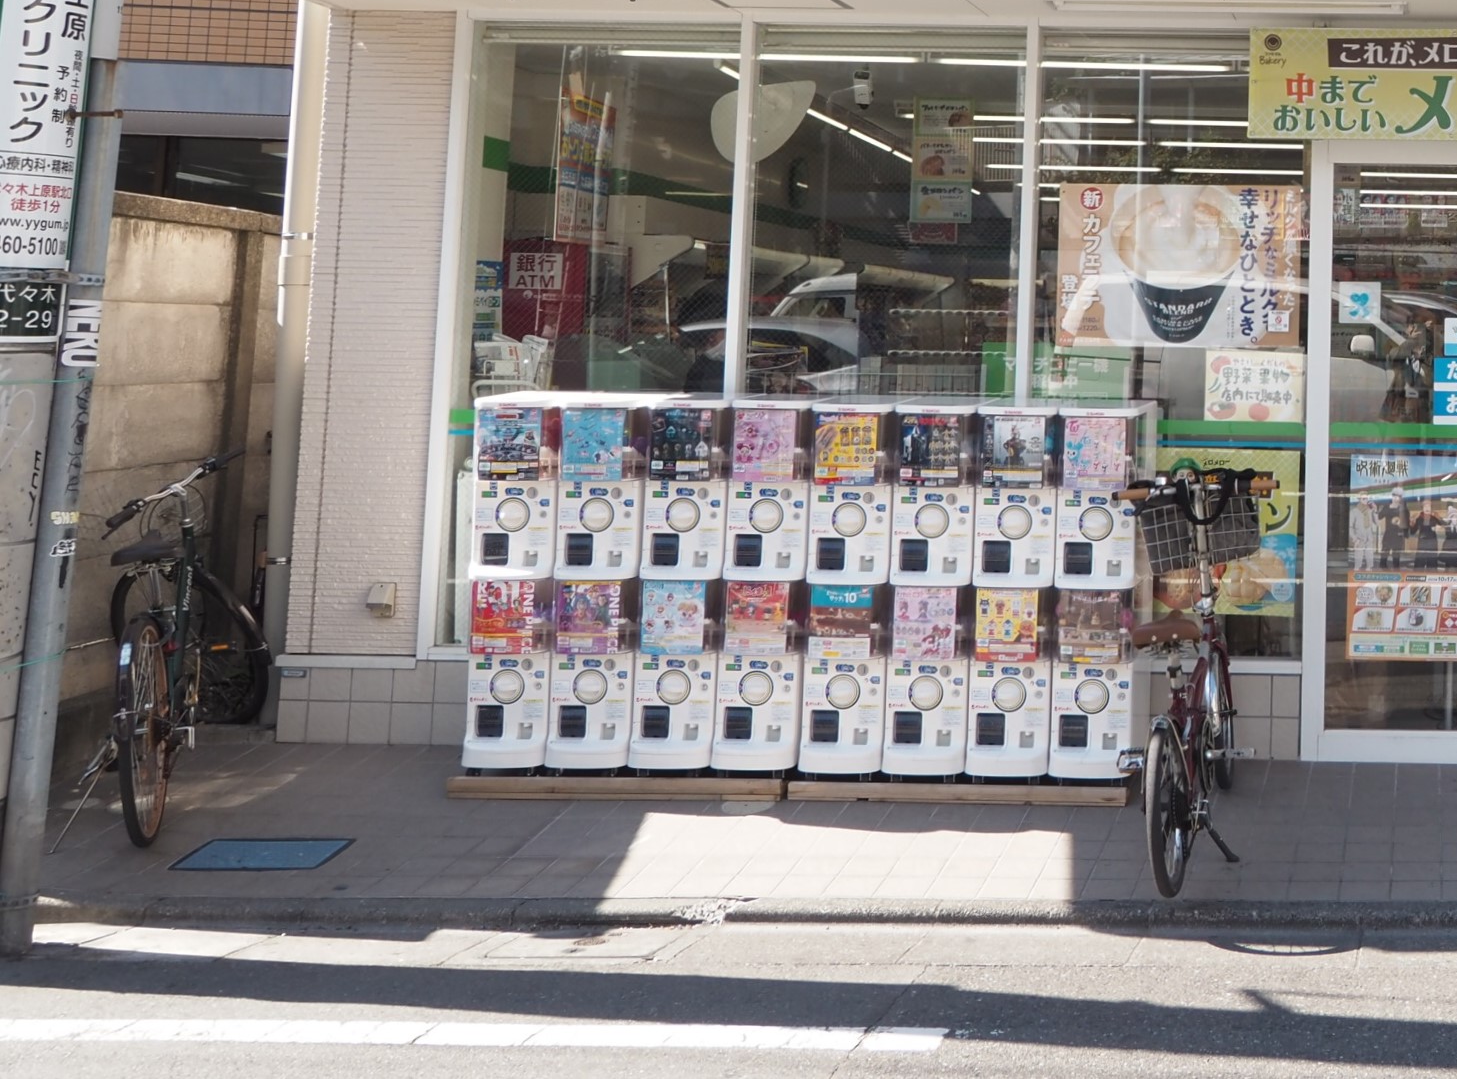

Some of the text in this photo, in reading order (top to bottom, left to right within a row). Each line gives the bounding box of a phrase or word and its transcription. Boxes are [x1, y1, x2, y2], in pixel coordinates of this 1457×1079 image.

[1259, 55, 1287, 69] Bakery
[51, 65, 70, 124] 予約制
[1286, 73, 1378, 104] 中まで
[1273, 105, 1387, 132] おいしい
[0, 182, 72, 200] 々木上原駅北口
[1083, 190, 1101, 207] 新
[11, 198, 61, 213] 徒歩1分
[0, 235, 58, 256] 60-5100
[516, 254, 557, 273] 銀行
[516, 275, 554, 288] ATM
[1222, 367, 1252, 385] 野菜
[844, 593, 857, 604] 10
